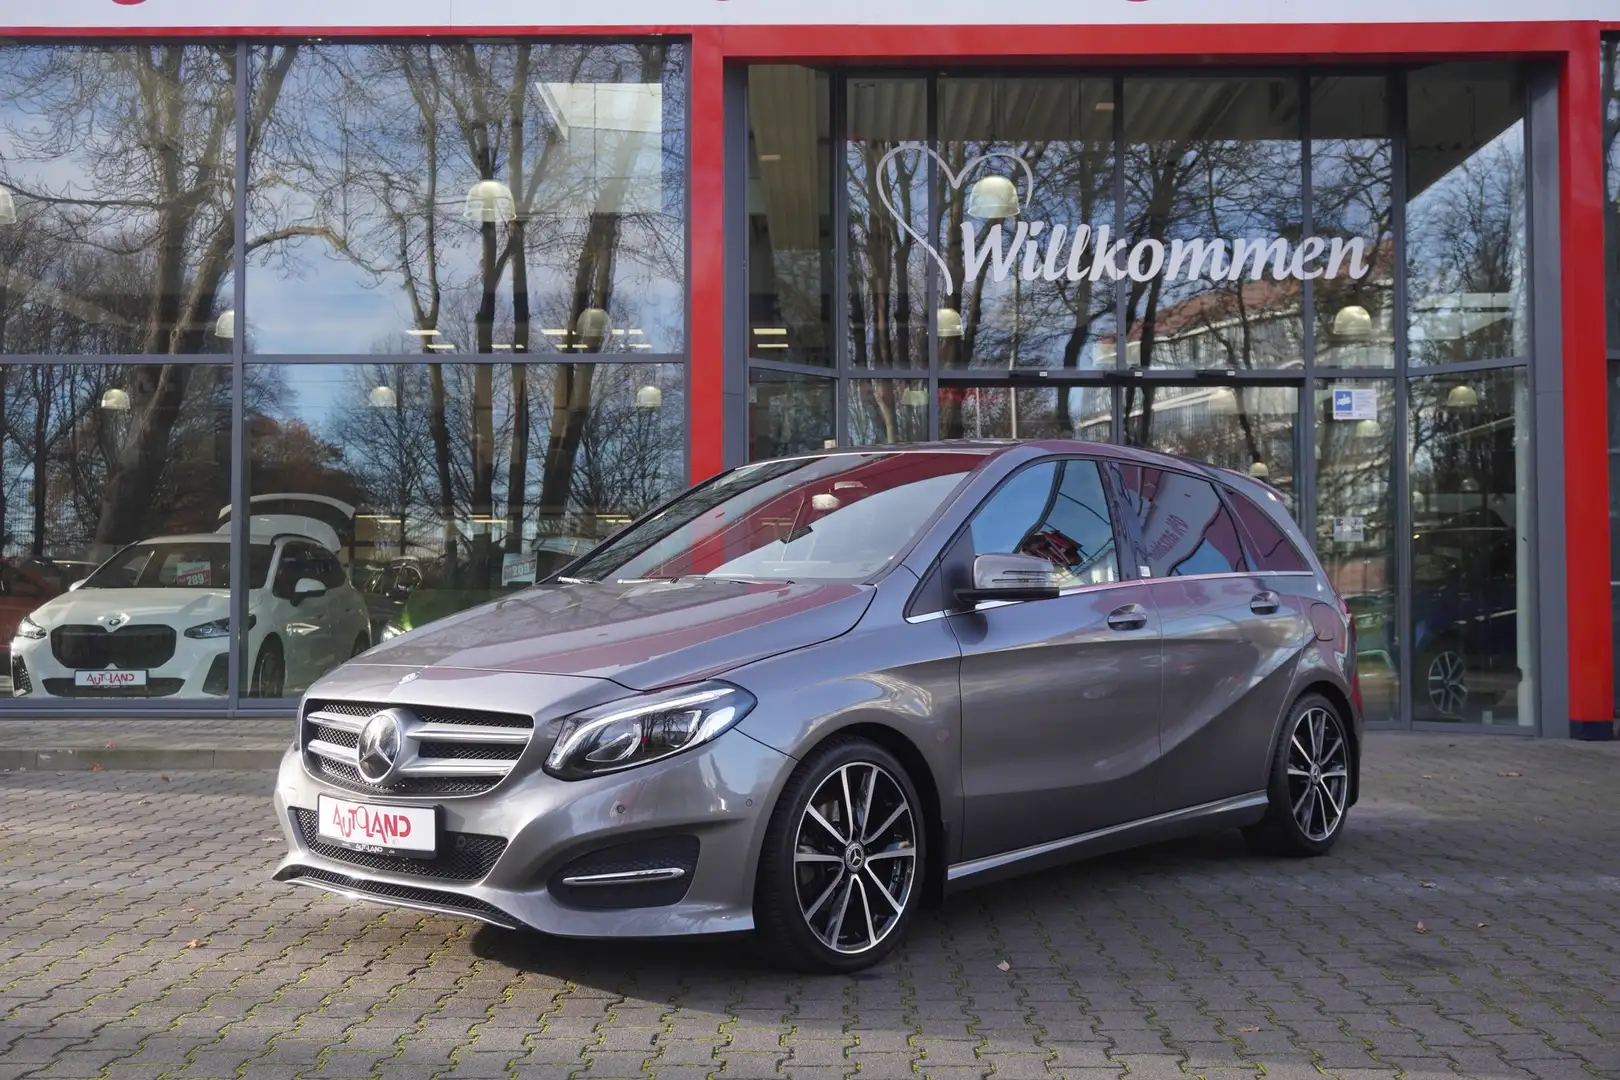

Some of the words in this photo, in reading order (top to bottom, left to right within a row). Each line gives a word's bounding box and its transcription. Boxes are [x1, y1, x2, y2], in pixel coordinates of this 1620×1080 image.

[961, 221, 1369, 282] Willkommen
[86, 672, 134, 685] AUTOLAND
[333, 804, 411, 843] AUTOLAND
